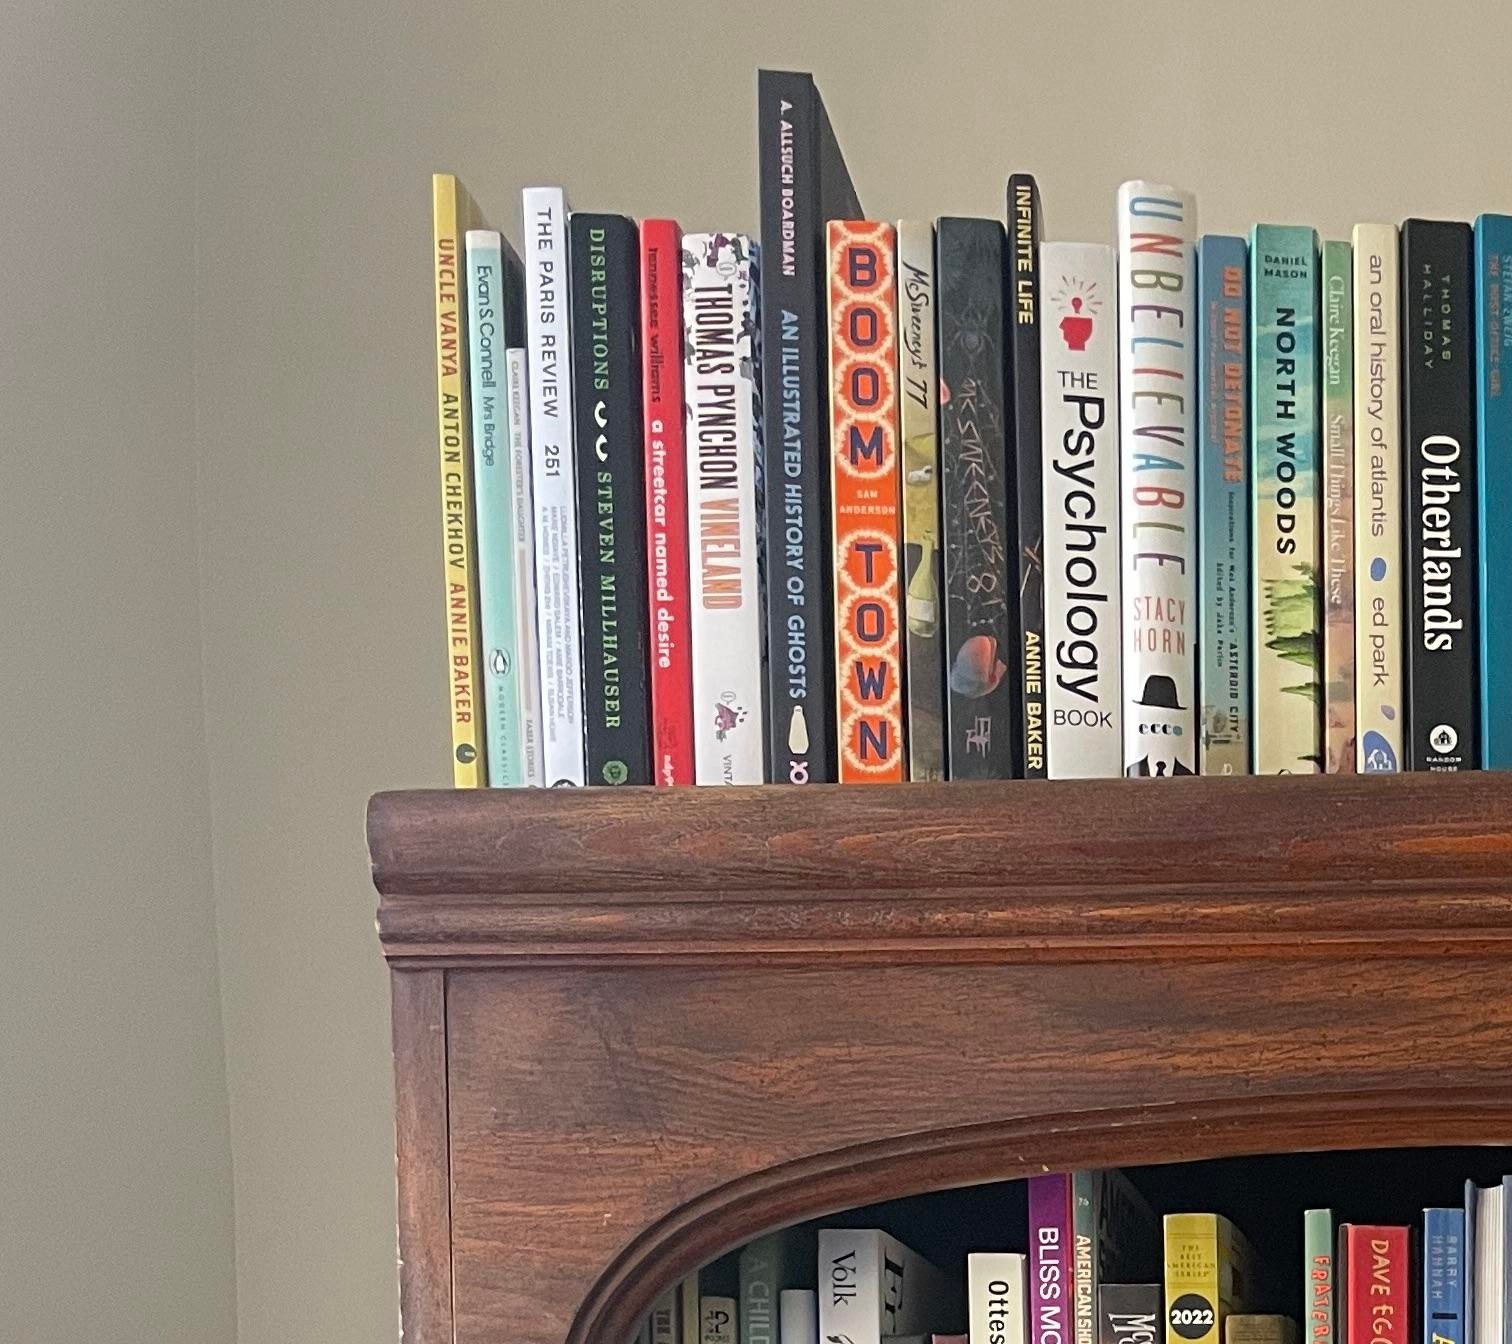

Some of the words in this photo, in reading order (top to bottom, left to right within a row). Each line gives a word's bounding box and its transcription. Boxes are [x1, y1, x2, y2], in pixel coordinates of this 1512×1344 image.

[536, 206, 555, 251] THE
[1015, 184, 1033, 273] INFINITE
[438, 237, 460, 308] UNCLE
[537, 260, 556, 327] PARIS
[1017, 280, 1034, 325] LIFE
[1368, 255, 1386, 287] an
[440, 311, 459, 378] VANYA
[588, 227, 610, 391] DISRUPTIONS
[693, 283, 736, 375] THOMAS
[780, 309, 802, 341] AN
[1369, 291, 1390, 336] oral
[540, 333, 559, 419] REVIEW
[846, 247, 888, 468] BOOM
[1057, 370, 1098, 392] THE
[1275, 306, 1296, 419] NORTH
[1367, 342, 1390, 420] history
[442, 392, 462, 466] ANTON
[696, 382, 738, 490] PYNCHON
[781, 348, 804, 479] ILLUSTRATED
[1370, 426, 1390, 450] of
[543, 444, 562, 479] 251
[1276, 432, 1297, 556] WOODS
[1369, 455, 1390, 538] atlantis
[445, 471, 467, 570] CHEKHOV
[596, 471, 616, 567] STEVEN
[699, 498, 743, 610] VINELAND
[783, 483, 805, 570] HISTORY
[1052, 393, 1107, 703] Psychology
[1420, 435, 1463, 652] Otherlands
[448, 582, 470, 649] ANNIE
[786, 575, 806, 607] OF
[1371, 596, 1390, 627] ed
[600, 574, 622, 729] MILLHAUSER
[787, 616, 808, 699] GHOSTS
[852, 542, 889, 761] TOWN
[1025, 630, 1041, 694] ANNIE
[1368, 633, 1390, 687] park
[452, 654, 473, 725] BAKER
[1052, 709, 1114, 728] BOOK
[1026, 701, 1044, 770] BAKER
[831, 1249, 858, 1306] Volk
[1037, 1226, 1061, 1299] BLISS
[1170, 1309, 1214, 1326] 2022
